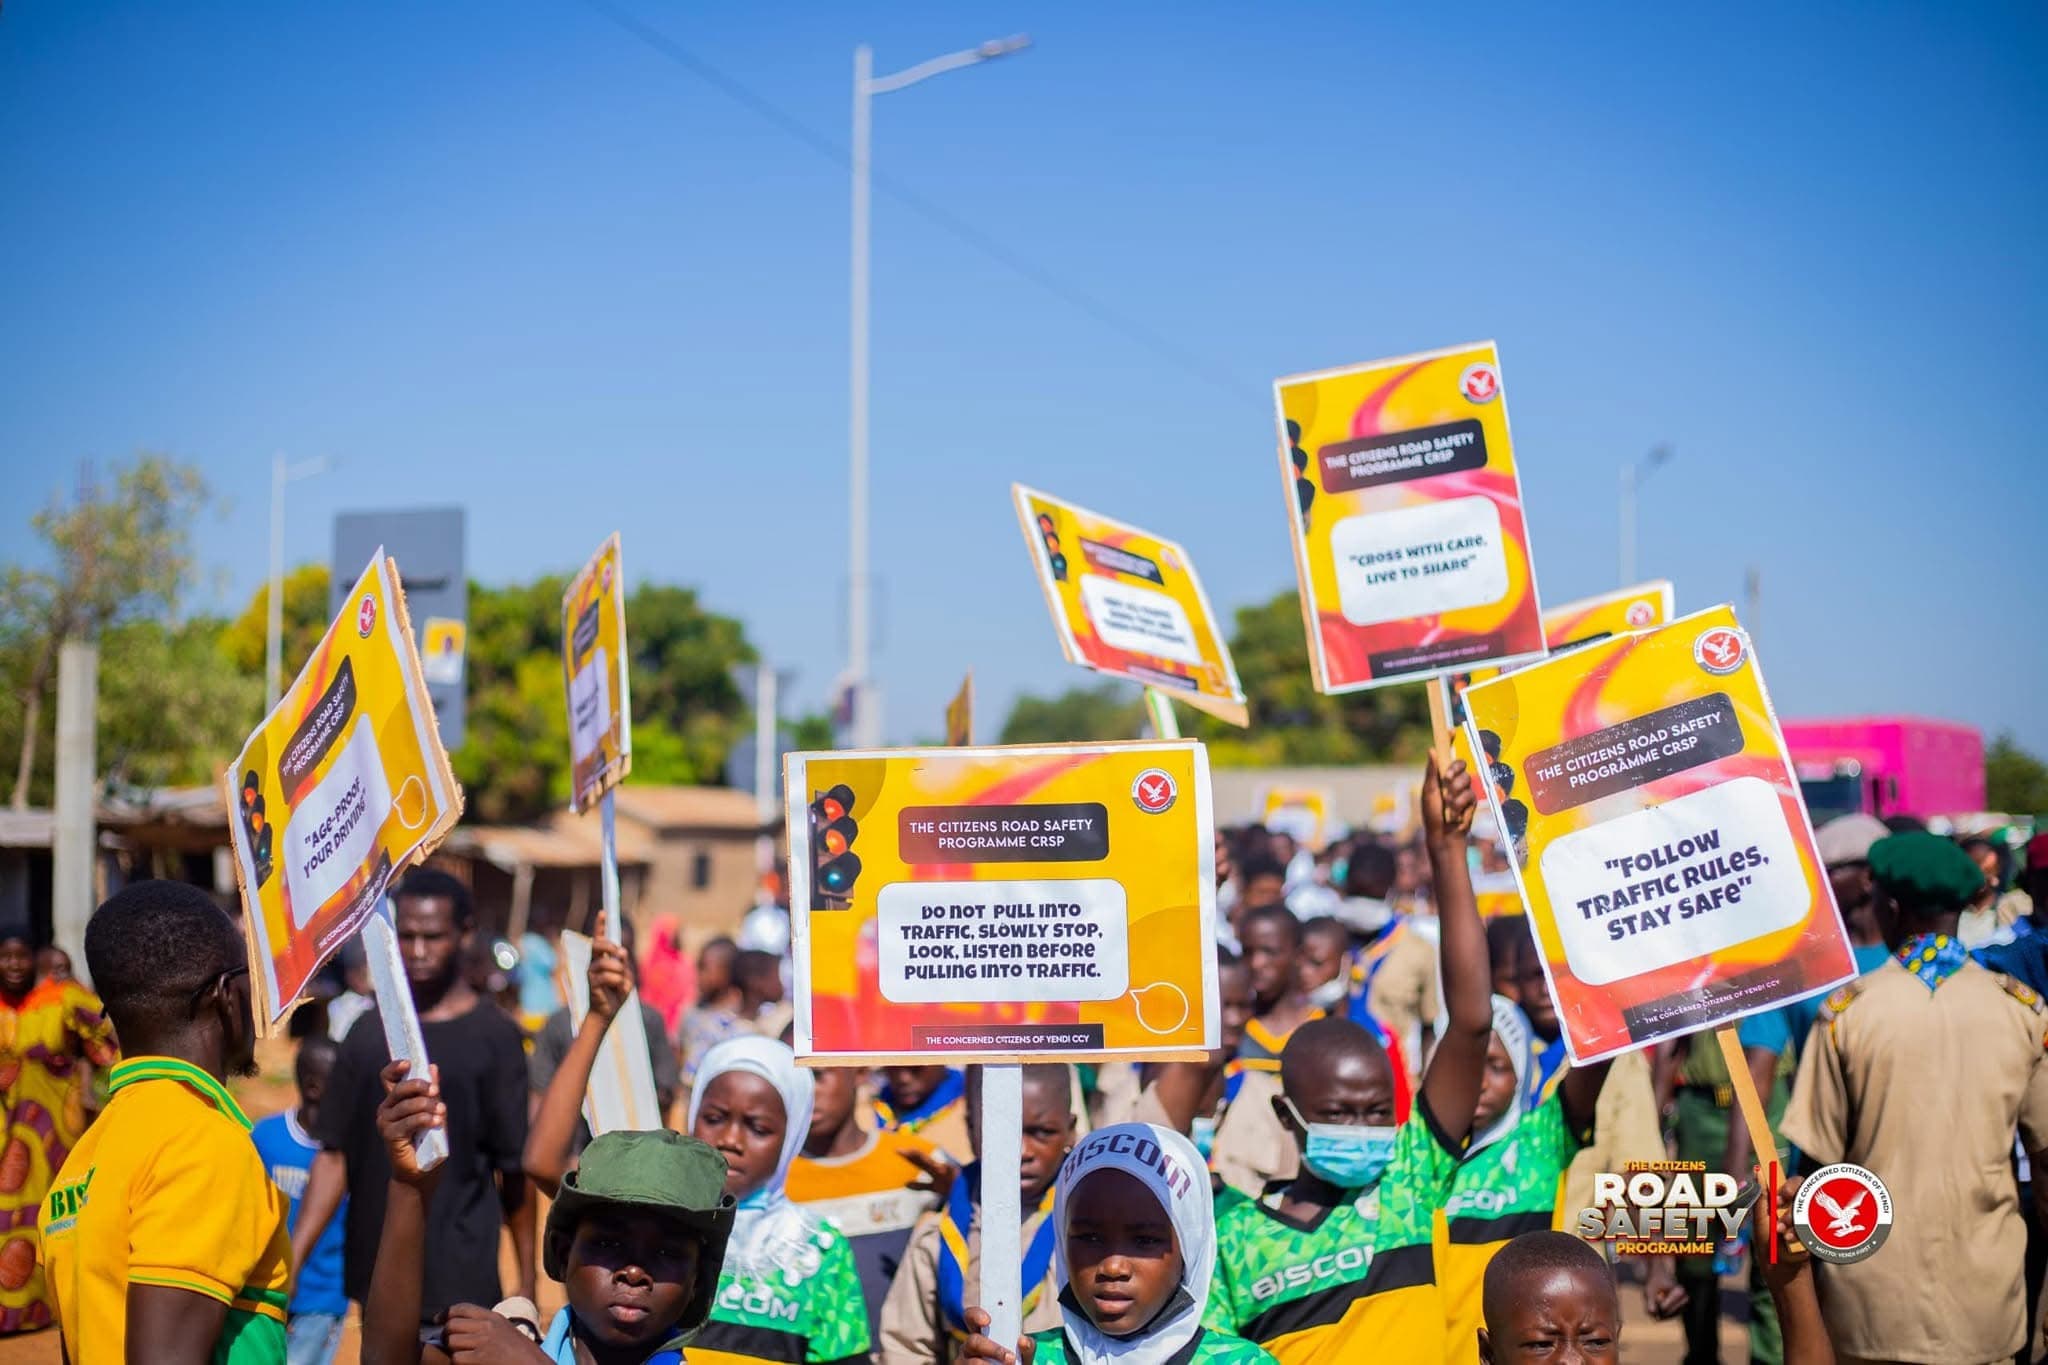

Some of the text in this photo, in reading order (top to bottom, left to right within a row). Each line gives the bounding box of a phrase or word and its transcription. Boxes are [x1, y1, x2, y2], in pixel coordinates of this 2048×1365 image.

[1406, 541, 1443, 558] WITH
[1401, 567, 1419, 579] TO
[316, 703, 334, 729] ROAD
[293, 722, 333, 775] PROGRAMME
[1536, 711, 1722, 782] THE CITIZENS ROAD SAFETY
[1569, 736, 1698, 788] PROGRAMME CRSP
[909, 818, 1093, 833] THE CITIZENS ROAD SAFETY
[938, 835, 1065, 849] PROGRAMME CRSP
[303, 841, 333, 879] YOUR
[1605, 829, 1720, 878] "FOLLOW
[1577, 846, 1769, 919] TRAFFIC RULES,
[921, 903, 1081, 920] DO NOT PULL INTO
[1607, 904, 1672, 940] STAY
[900, 922, 1103, 940] TRAFFIC, SLOWLY STOP,
[908, 942, 1096, 961] LOOK, LISTEN BEFORE
[904, 962, 1101, 980] PULLING INTO TRAFFIC.
[1644, 1015, 1659, 1025] THE
[1659, 1003, 1702, 1020] CONCERNED
[1702, 995, 1734, 1009] CITIZENS
[1734, 990, 1744, 999] OF
[1744, 984, 1766, 996] YENDI
[926, 1034, 1090, 1045] THE CONCERNED CITIZENS OF YENDI CCY
